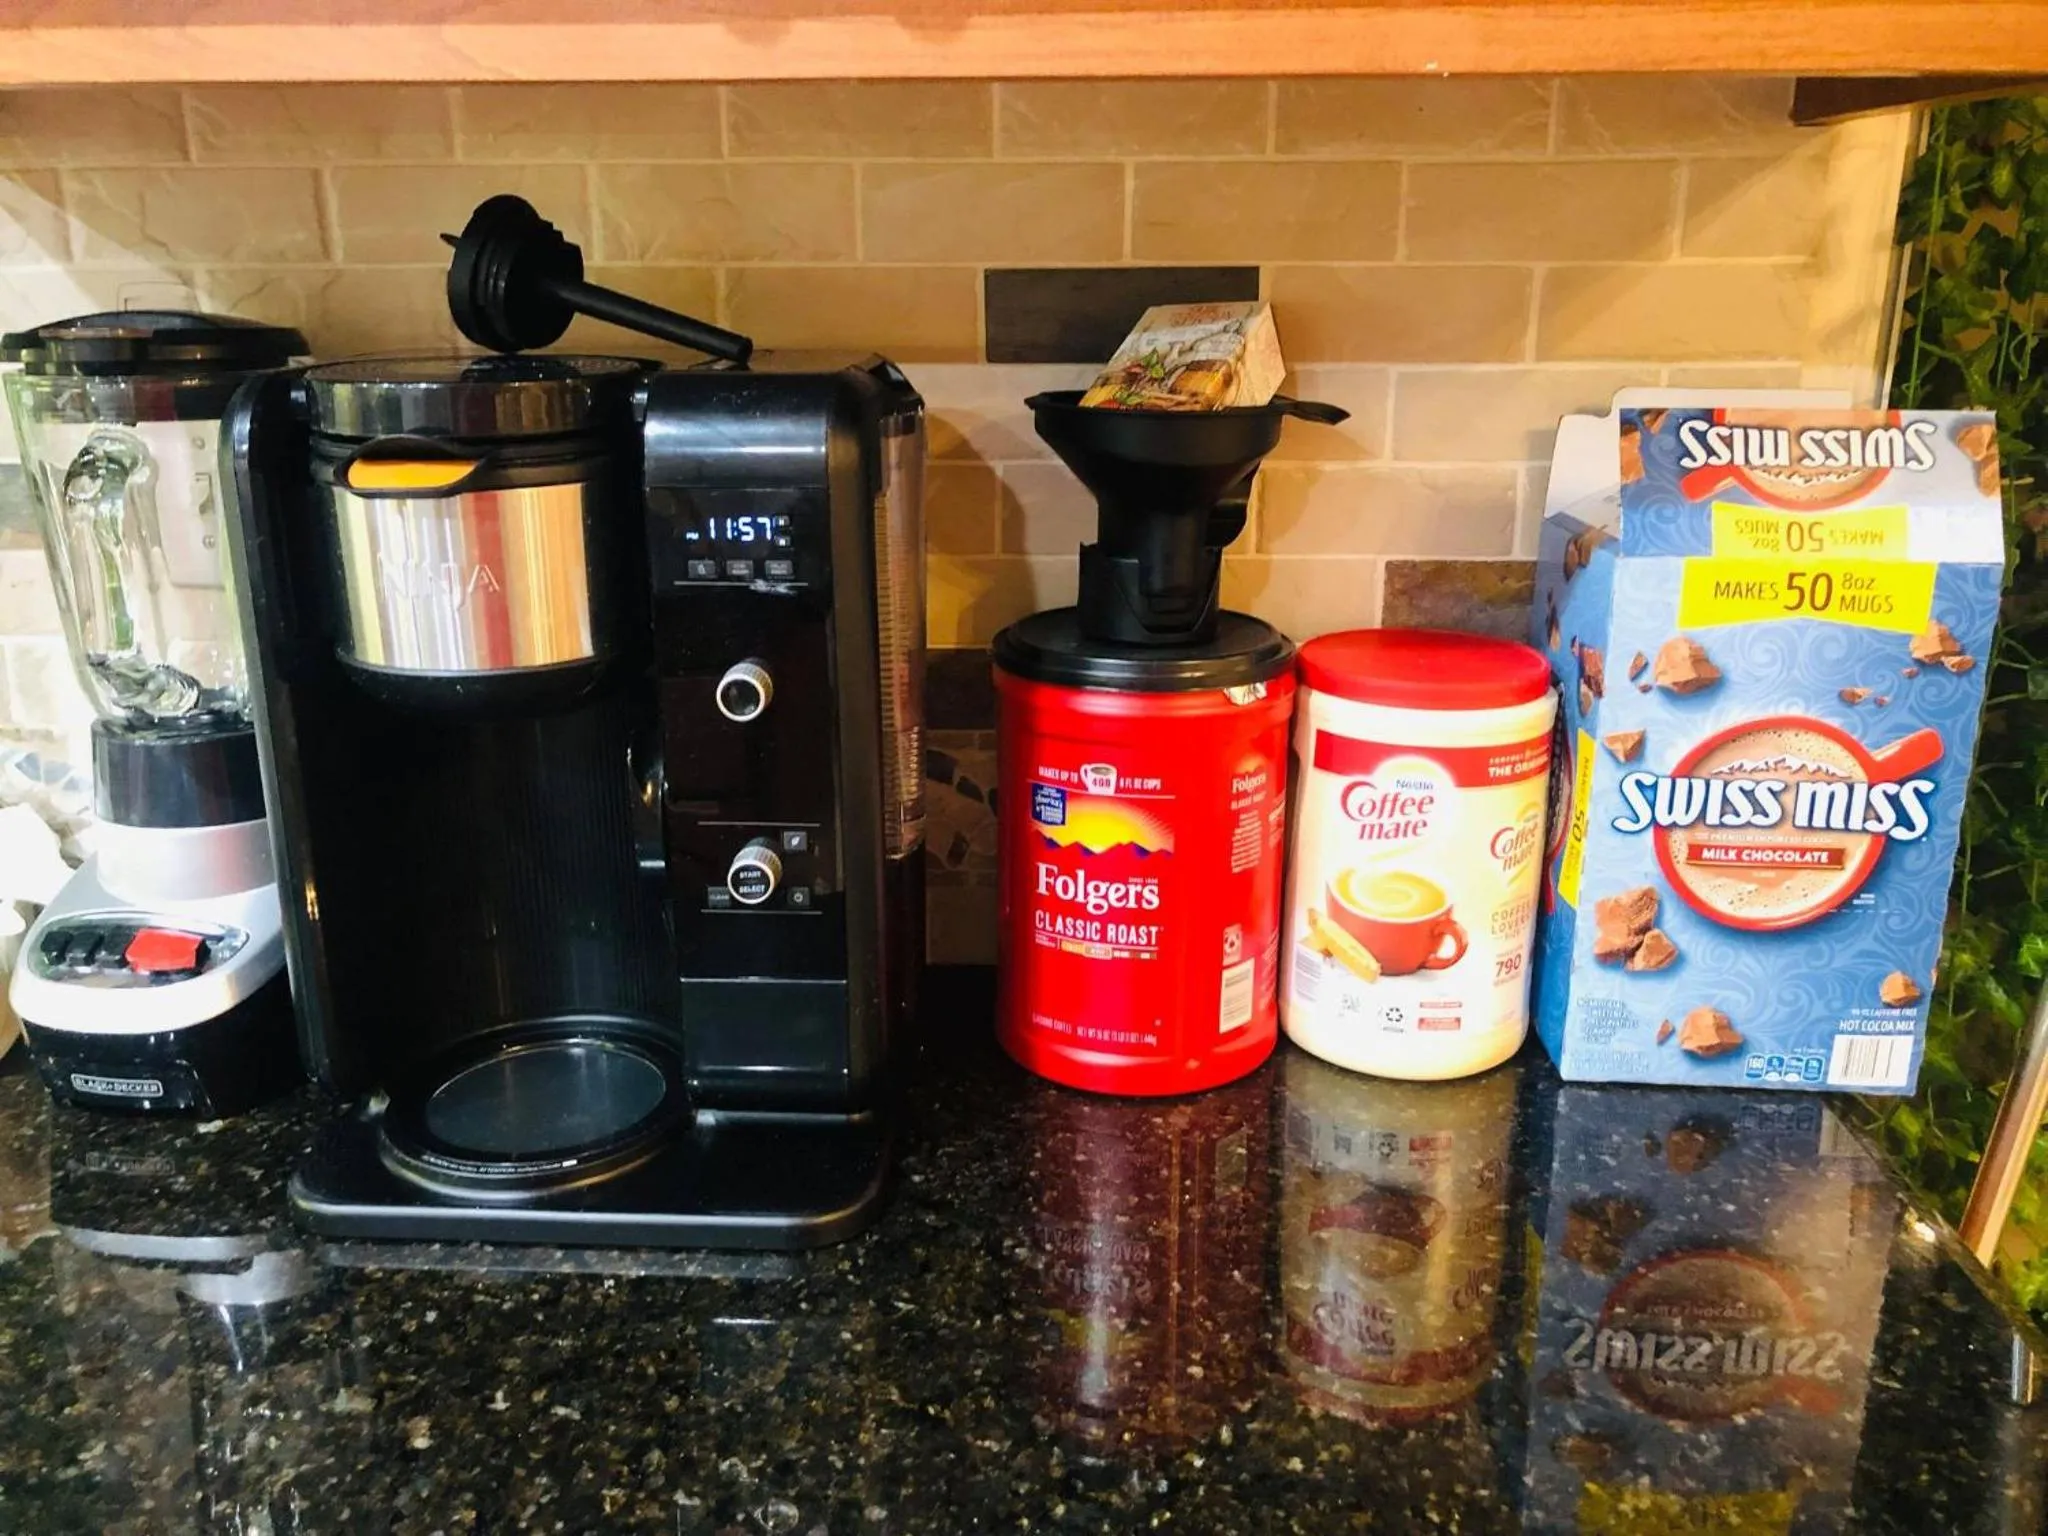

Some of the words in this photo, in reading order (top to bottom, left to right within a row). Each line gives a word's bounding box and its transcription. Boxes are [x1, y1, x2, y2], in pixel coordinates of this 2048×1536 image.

[1679, 419, 1790, 469] MISS
[1800, 421, 1937, 472] SWISS
[709, 516, 772, 541] 11:57
[1735, 518, 1780, 535] MUGS
[1786, 521, 1825, 552] 50
[1714, 579, 1779, 601] MAKES
[1783, 571, 1833, 611] 50
[1839, 594, 1894, 614] MUGS
[1488, 765, 1512, 778] THE
[1340, 780, 1435, 822] Coffee
[1611, 771, 1787, 834] SWISS
[1793, 778, 1937, 841] MISS
[1358, 819, 1428, 840] mate
[1489, 821, 1539, 860] Coffee
[1702, 847, 1738, 860] MILK
[1742, 849, 1829, 863] CHOCOLATE
[739, 870, 761, 879] START
[739, 884, 765, 894] SELECT
[1035, 861, 1160, 916] Folgers
[1035, 909, 1101, 941] CLASSIC
[1107, 923, 1159, 946] ROAST
[1495, 953, 1523, 978] 790
[1838, 1019, 1860, 1032] HOT
[1861, 1020, 1895, 1032] COCOA
[1895, 1020, 1916, 1032] MIX
